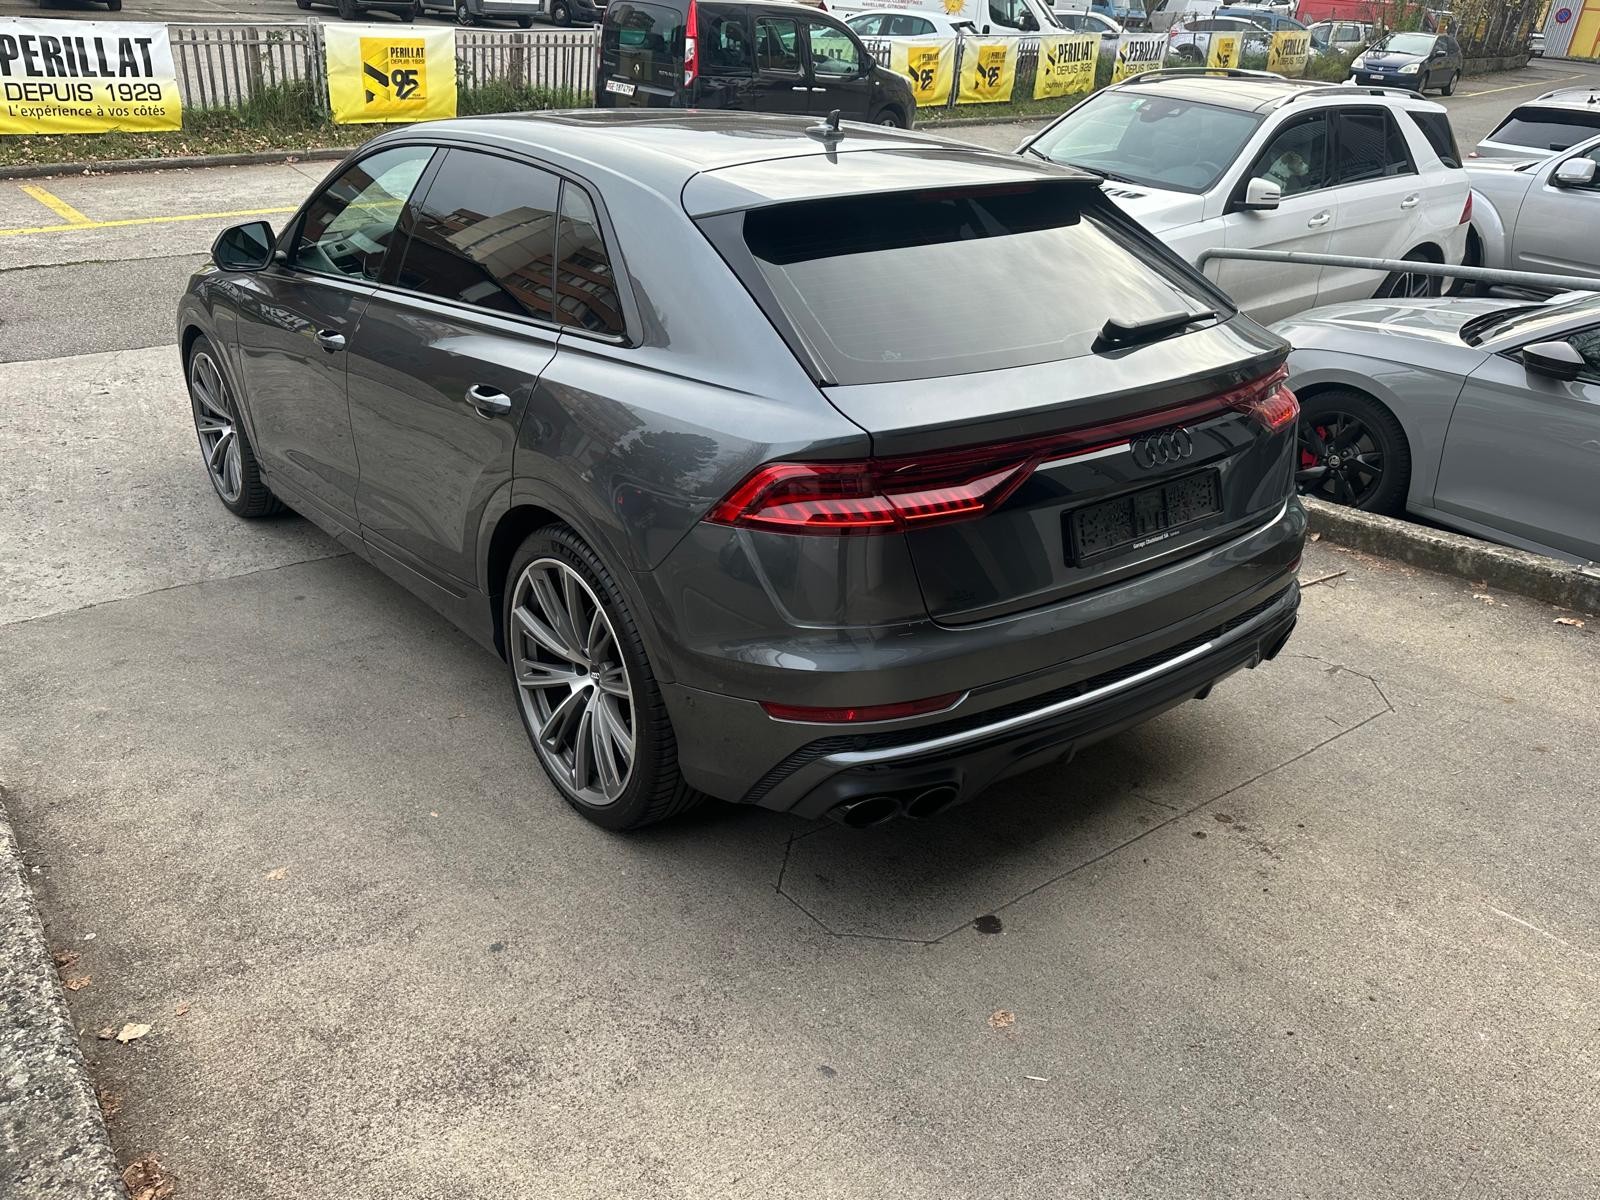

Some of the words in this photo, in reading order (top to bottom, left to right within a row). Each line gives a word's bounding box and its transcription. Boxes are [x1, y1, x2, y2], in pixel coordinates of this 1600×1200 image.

[0, 34, 153, 78] PERILLAT
[390, 47, 425, 58] PERILLAT
[1129, 40, 1165, 62] PERILLAT
[920, 69, 935, 91] 95
[987, 66, 1001, 88] 95
[1056, 64, 1079, 76] DEPUIS
[4, 82, 94, 102] DEPUIS
[105, 83, 162, 102] 1929
[391, 69, 419, 100] 95
[9, 105, 92, 119] L'expérience
[96, 105, 104, 117] à
[108, 108, 129, 117] vos
[134, 105, 166, 116] côtés
